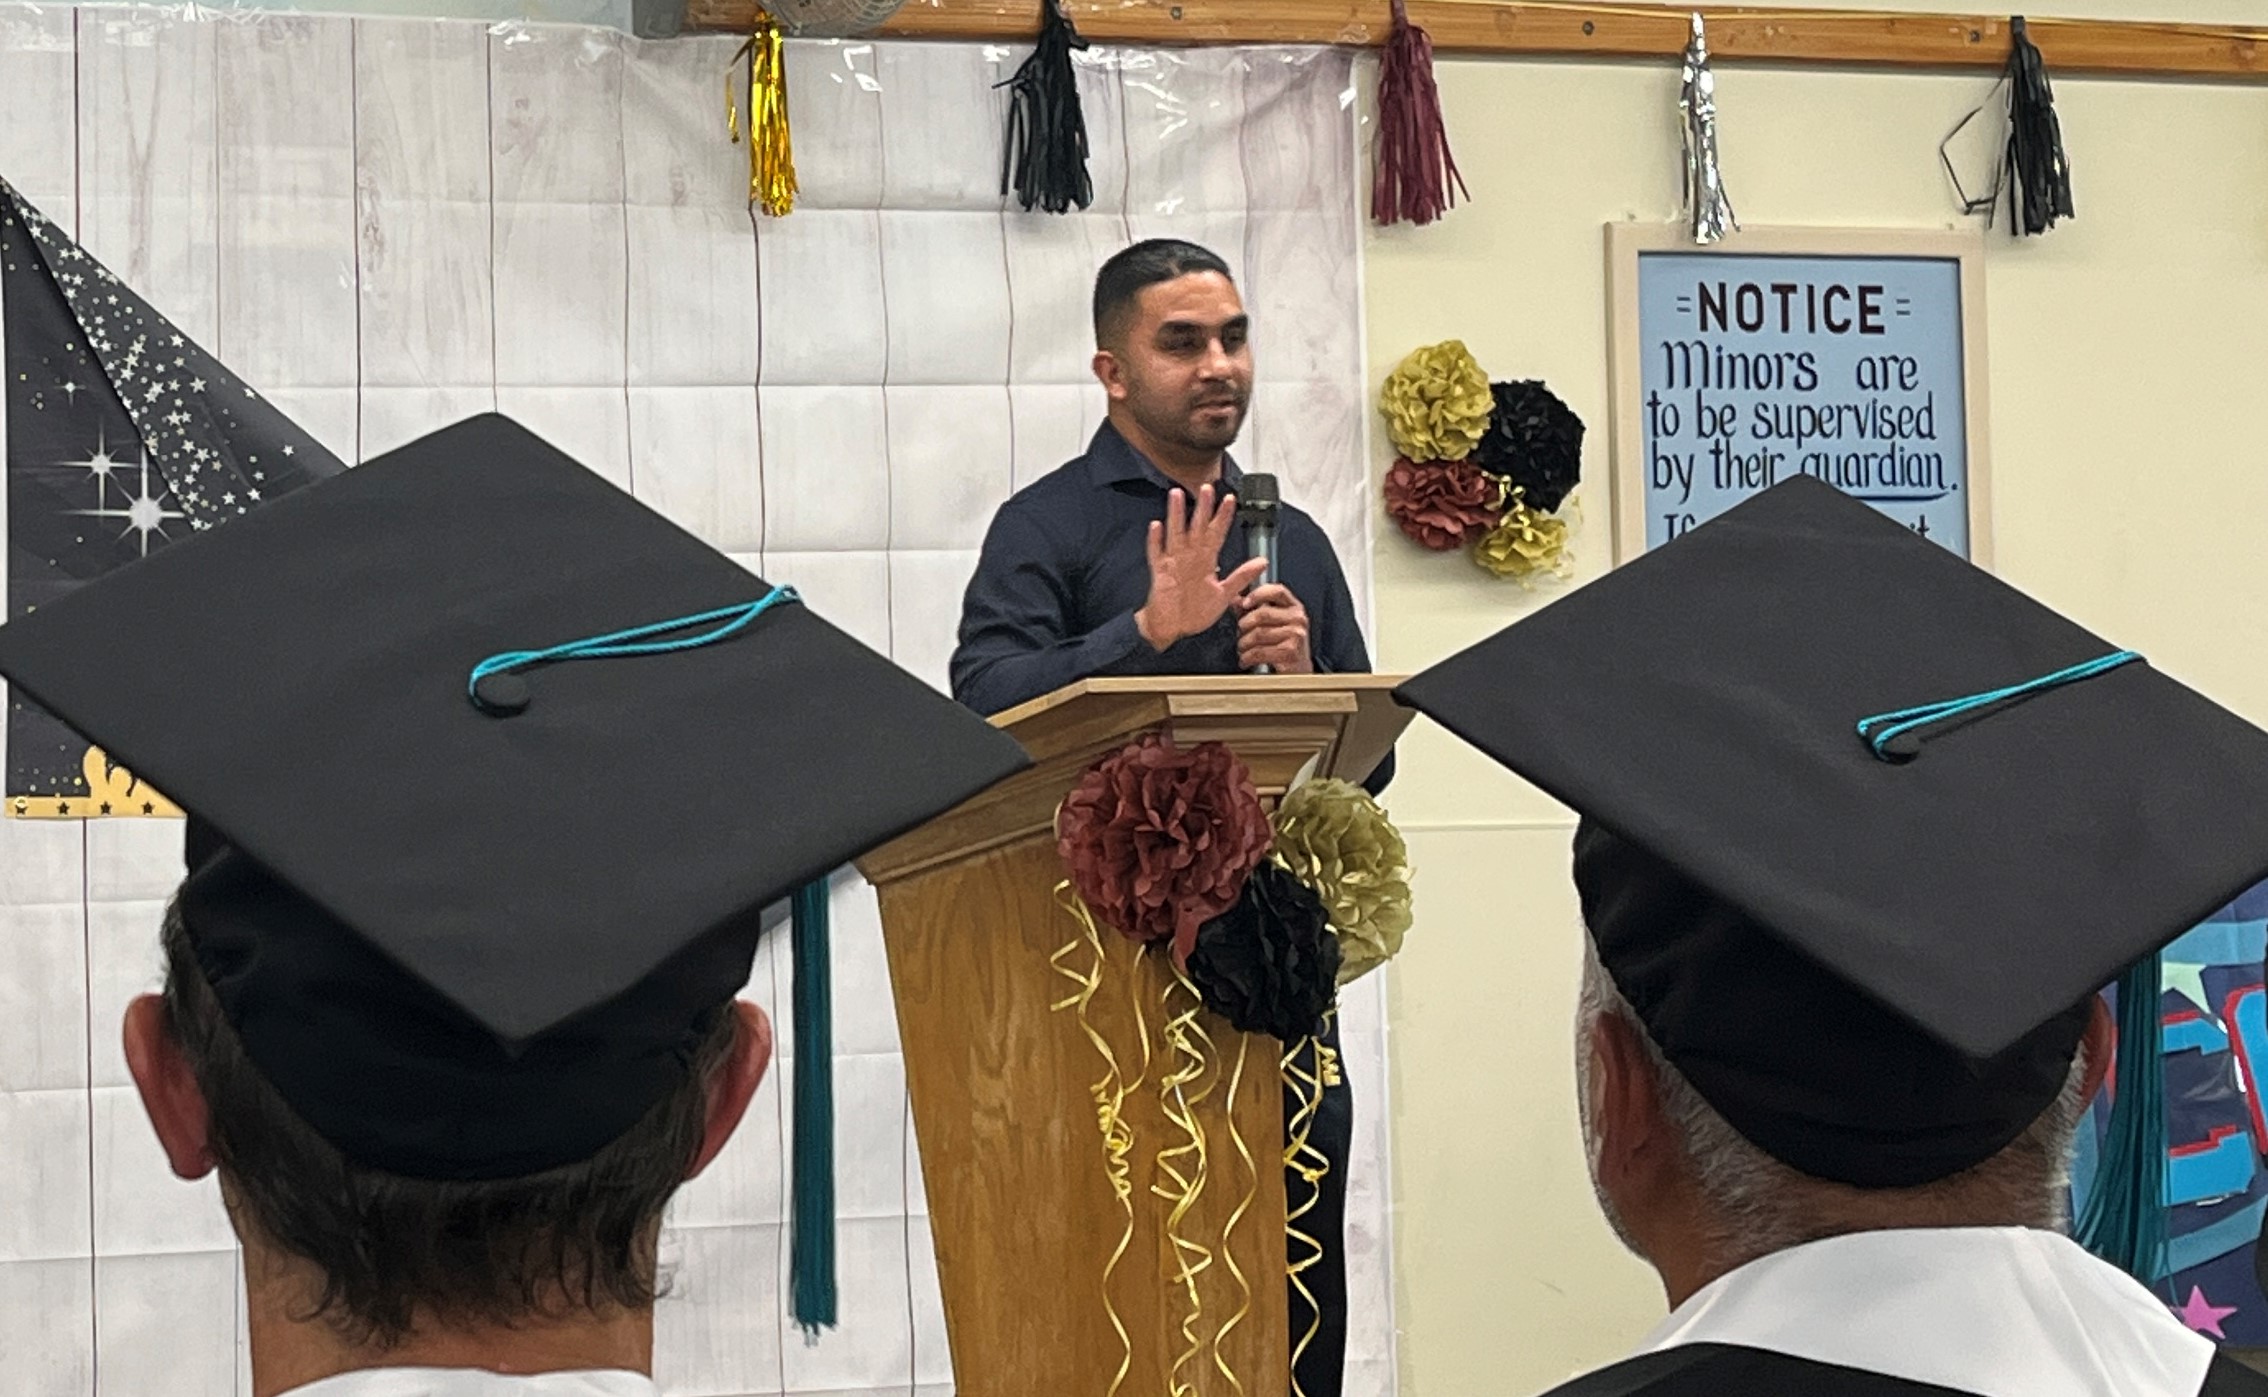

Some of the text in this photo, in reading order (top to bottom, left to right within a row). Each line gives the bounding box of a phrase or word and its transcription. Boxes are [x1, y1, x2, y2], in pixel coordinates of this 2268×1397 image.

[1698, 282, 1885, 334] NOTICE
[1660, 340, 1919, 391] Minors are
[1646, 388, 1937, 449] to be supervised
[1652, 440, 1694, 505] by
[1709, 438, 1785, 489] their
